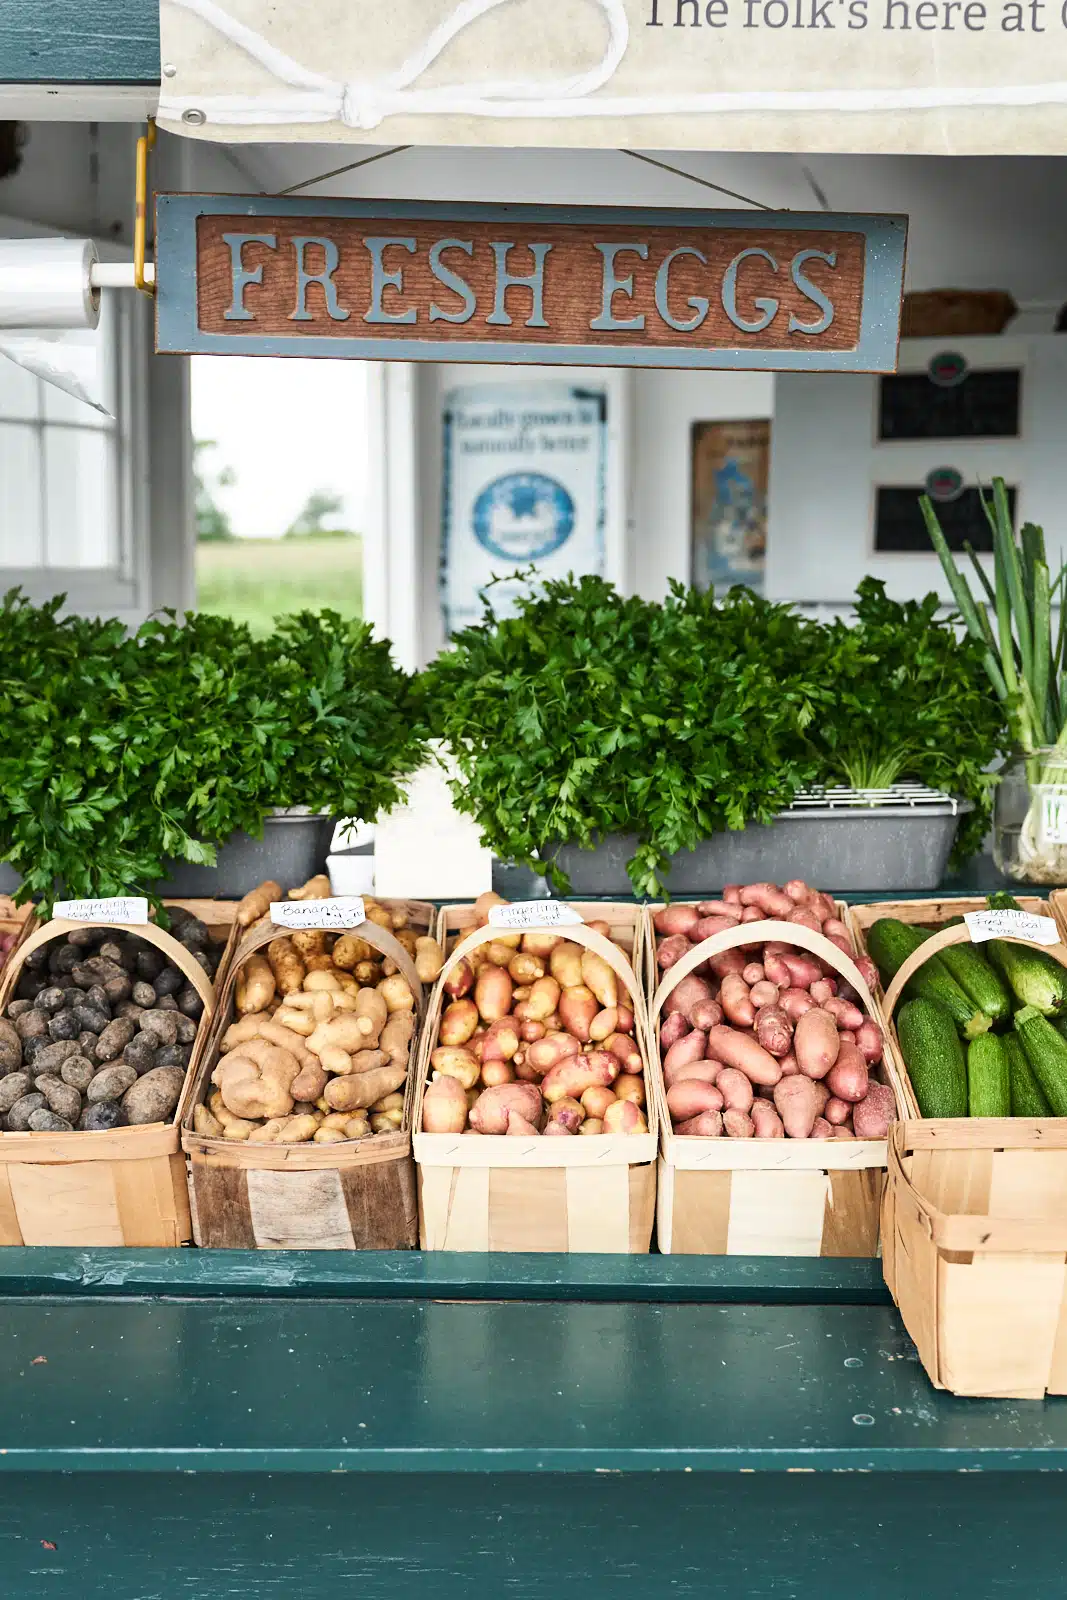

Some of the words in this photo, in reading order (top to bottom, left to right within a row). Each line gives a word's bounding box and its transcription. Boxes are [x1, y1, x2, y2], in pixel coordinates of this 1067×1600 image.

[646, 0, 728, 28] The
[742, 0, 868, 29] folk's
[883, 0, 986, 31] here
[1001, 0, 1045, 32] at
[222, 233, 552, 327] FRESH
[589, 243, 838, 335] EGGS
[281, 904, 344, 915] Banana
